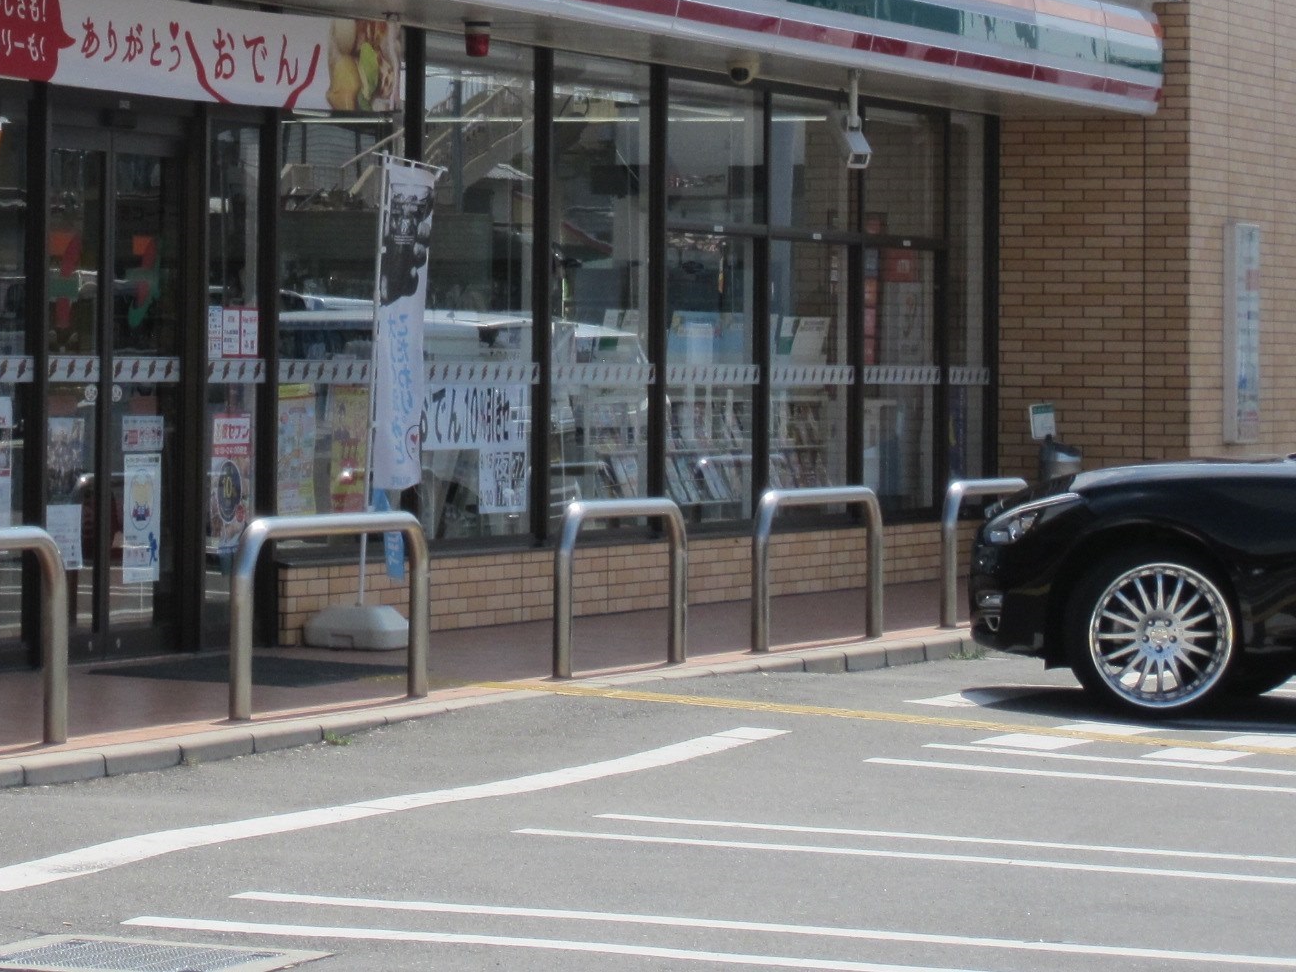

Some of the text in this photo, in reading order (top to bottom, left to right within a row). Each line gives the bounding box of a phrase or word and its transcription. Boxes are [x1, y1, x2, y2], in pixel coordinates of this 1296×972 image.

[81, 17, 298, 85] ありがとう おでん
